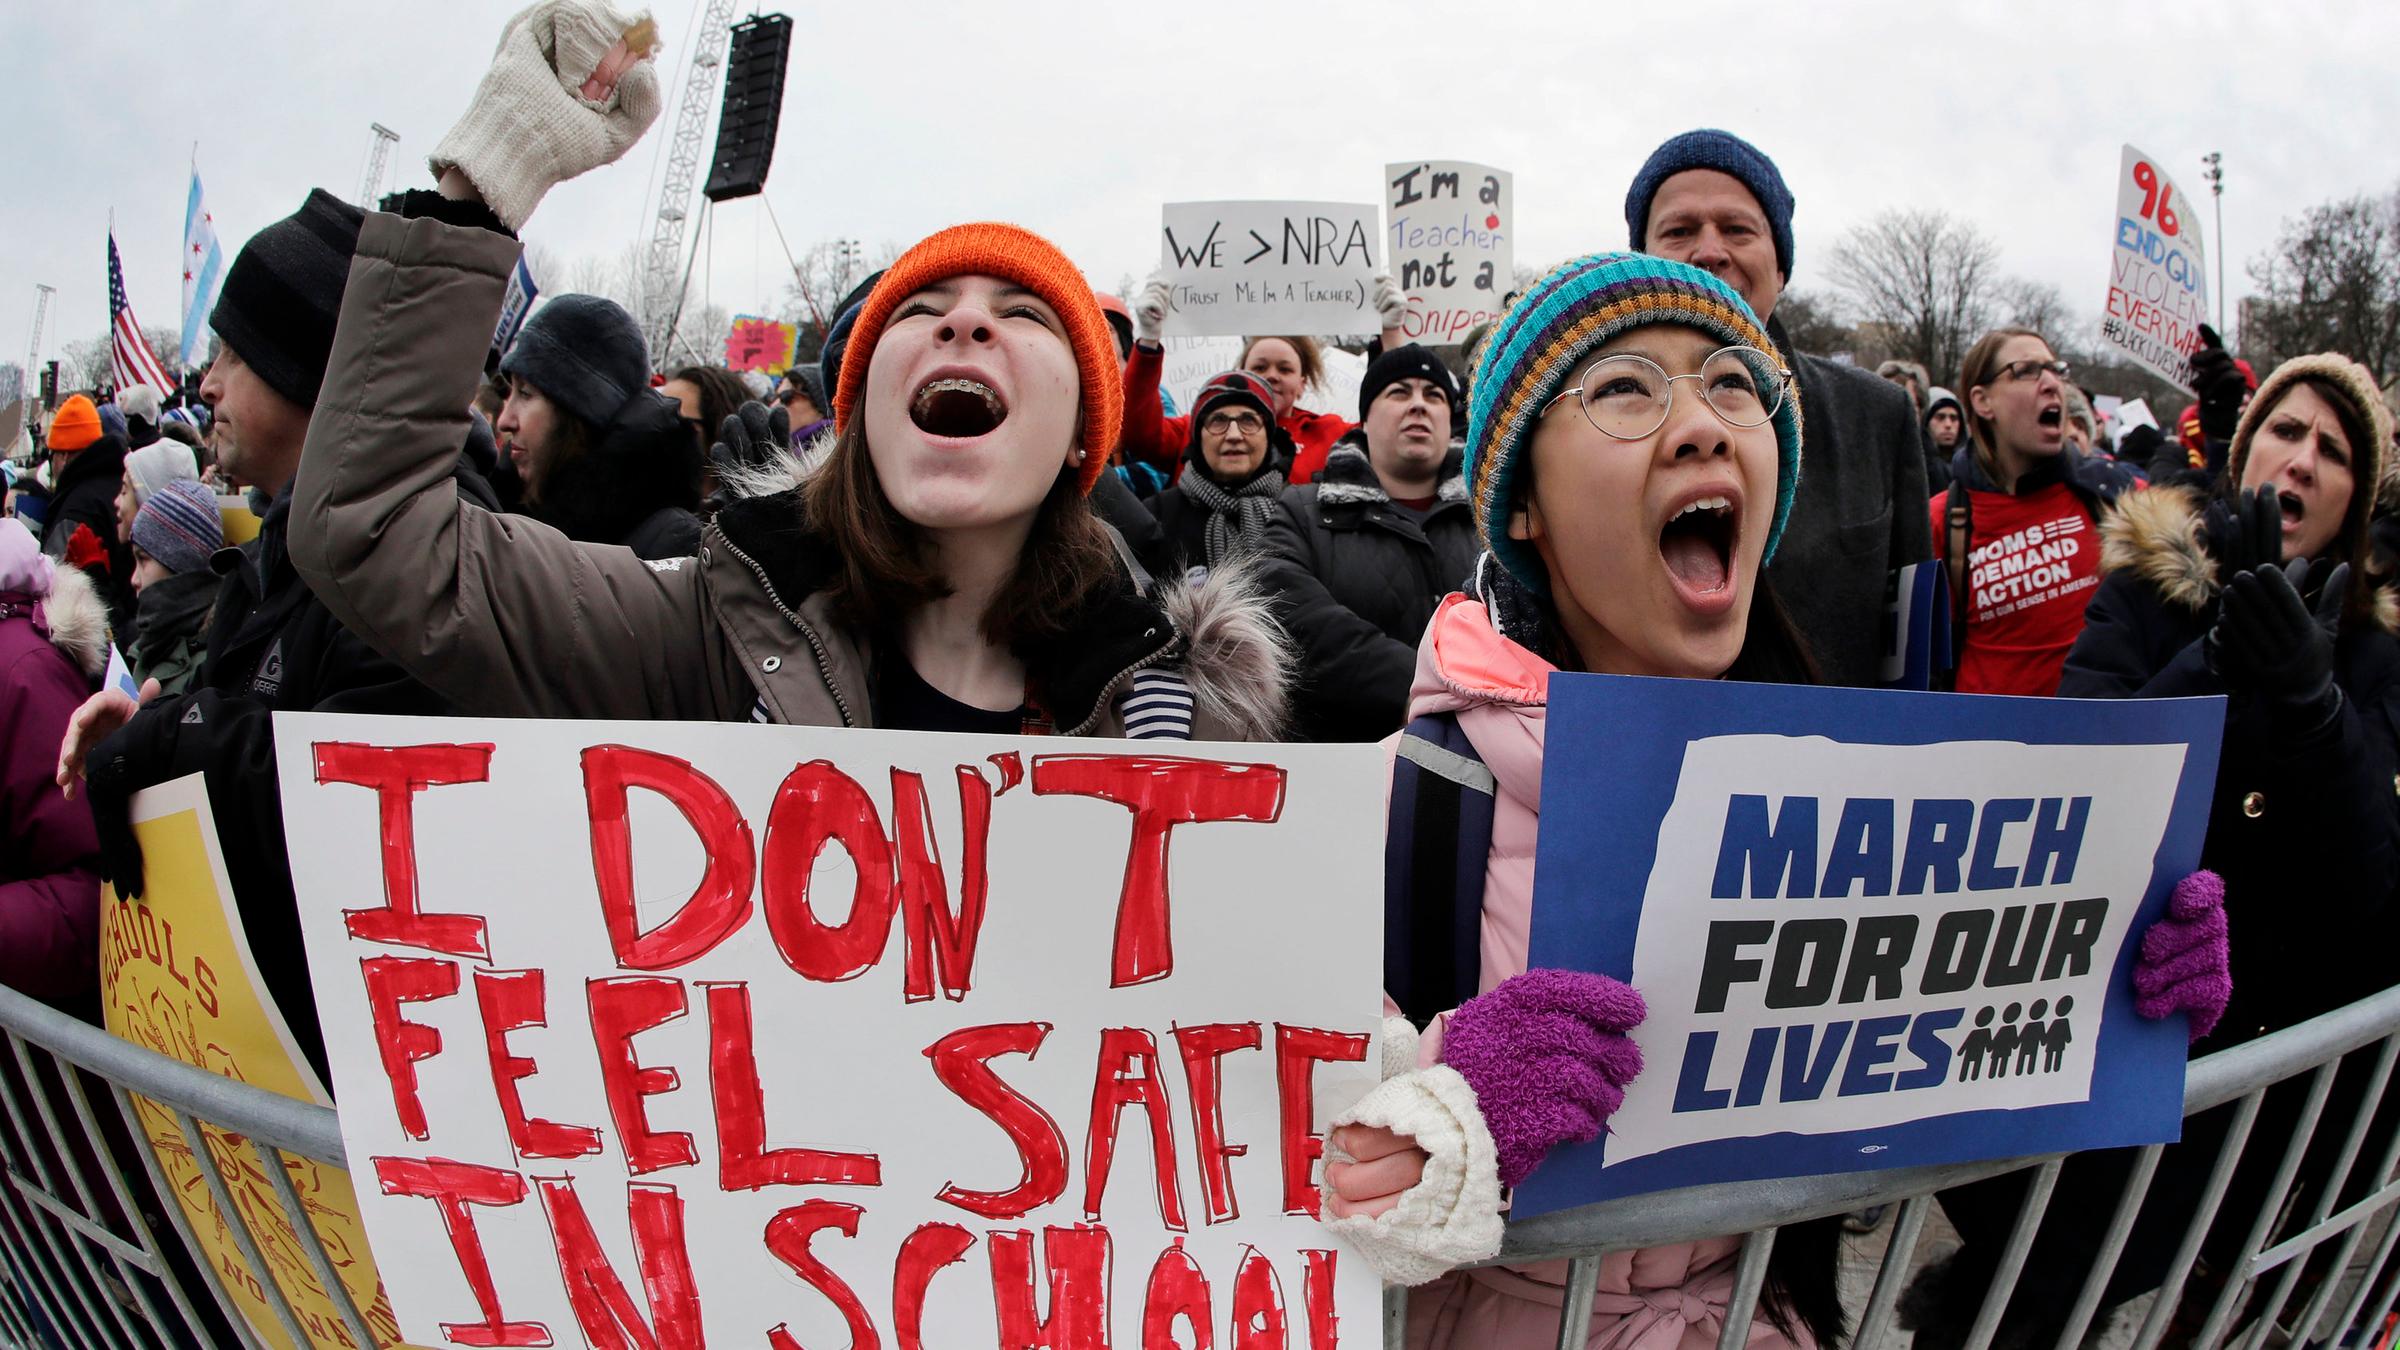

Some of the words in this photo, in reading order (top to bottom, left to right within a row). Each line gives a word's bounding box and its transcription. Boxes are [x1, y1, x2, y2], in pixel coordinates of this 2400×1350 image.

[1391, 164, 1459, 209] I'm
[1479, 175, 1500, 211] a
[2133, 160, 2179, 237] 96
[1282, 217, 1372, 268] NRA
[1391, 213, 1504, 249] Teacher
[2117, 217, 2165, 266] END
[1284, 283, 1295, 301] A
[1402, 252, 1456, 291] not
[1474, 260, 1496, 294] a
[1968, 525, 2044, 569] MOMS
[1972, 538, 2079, 590] DEMAND
[1977, 560, 2071, 609] ACTION
[1710, 793, 2093, 899] MARCH
[311, 741, 496, 966] I
[580, 744, 1288, 1004] DON'T
[105, 901, 219, 1018] SCHOOLS
[1694, 914, 1920, 1014] FOR
[1919, 897, 2110, 996] OUR
[1671, 1007, 1966, 1114] LIVES
[360, 954, 882, 1191] FEEL
[922, 1020, 1371, 1233] SAFE
[369, 1155, 706, 1350] IN
[293, 1304, 358, 1350] WA
